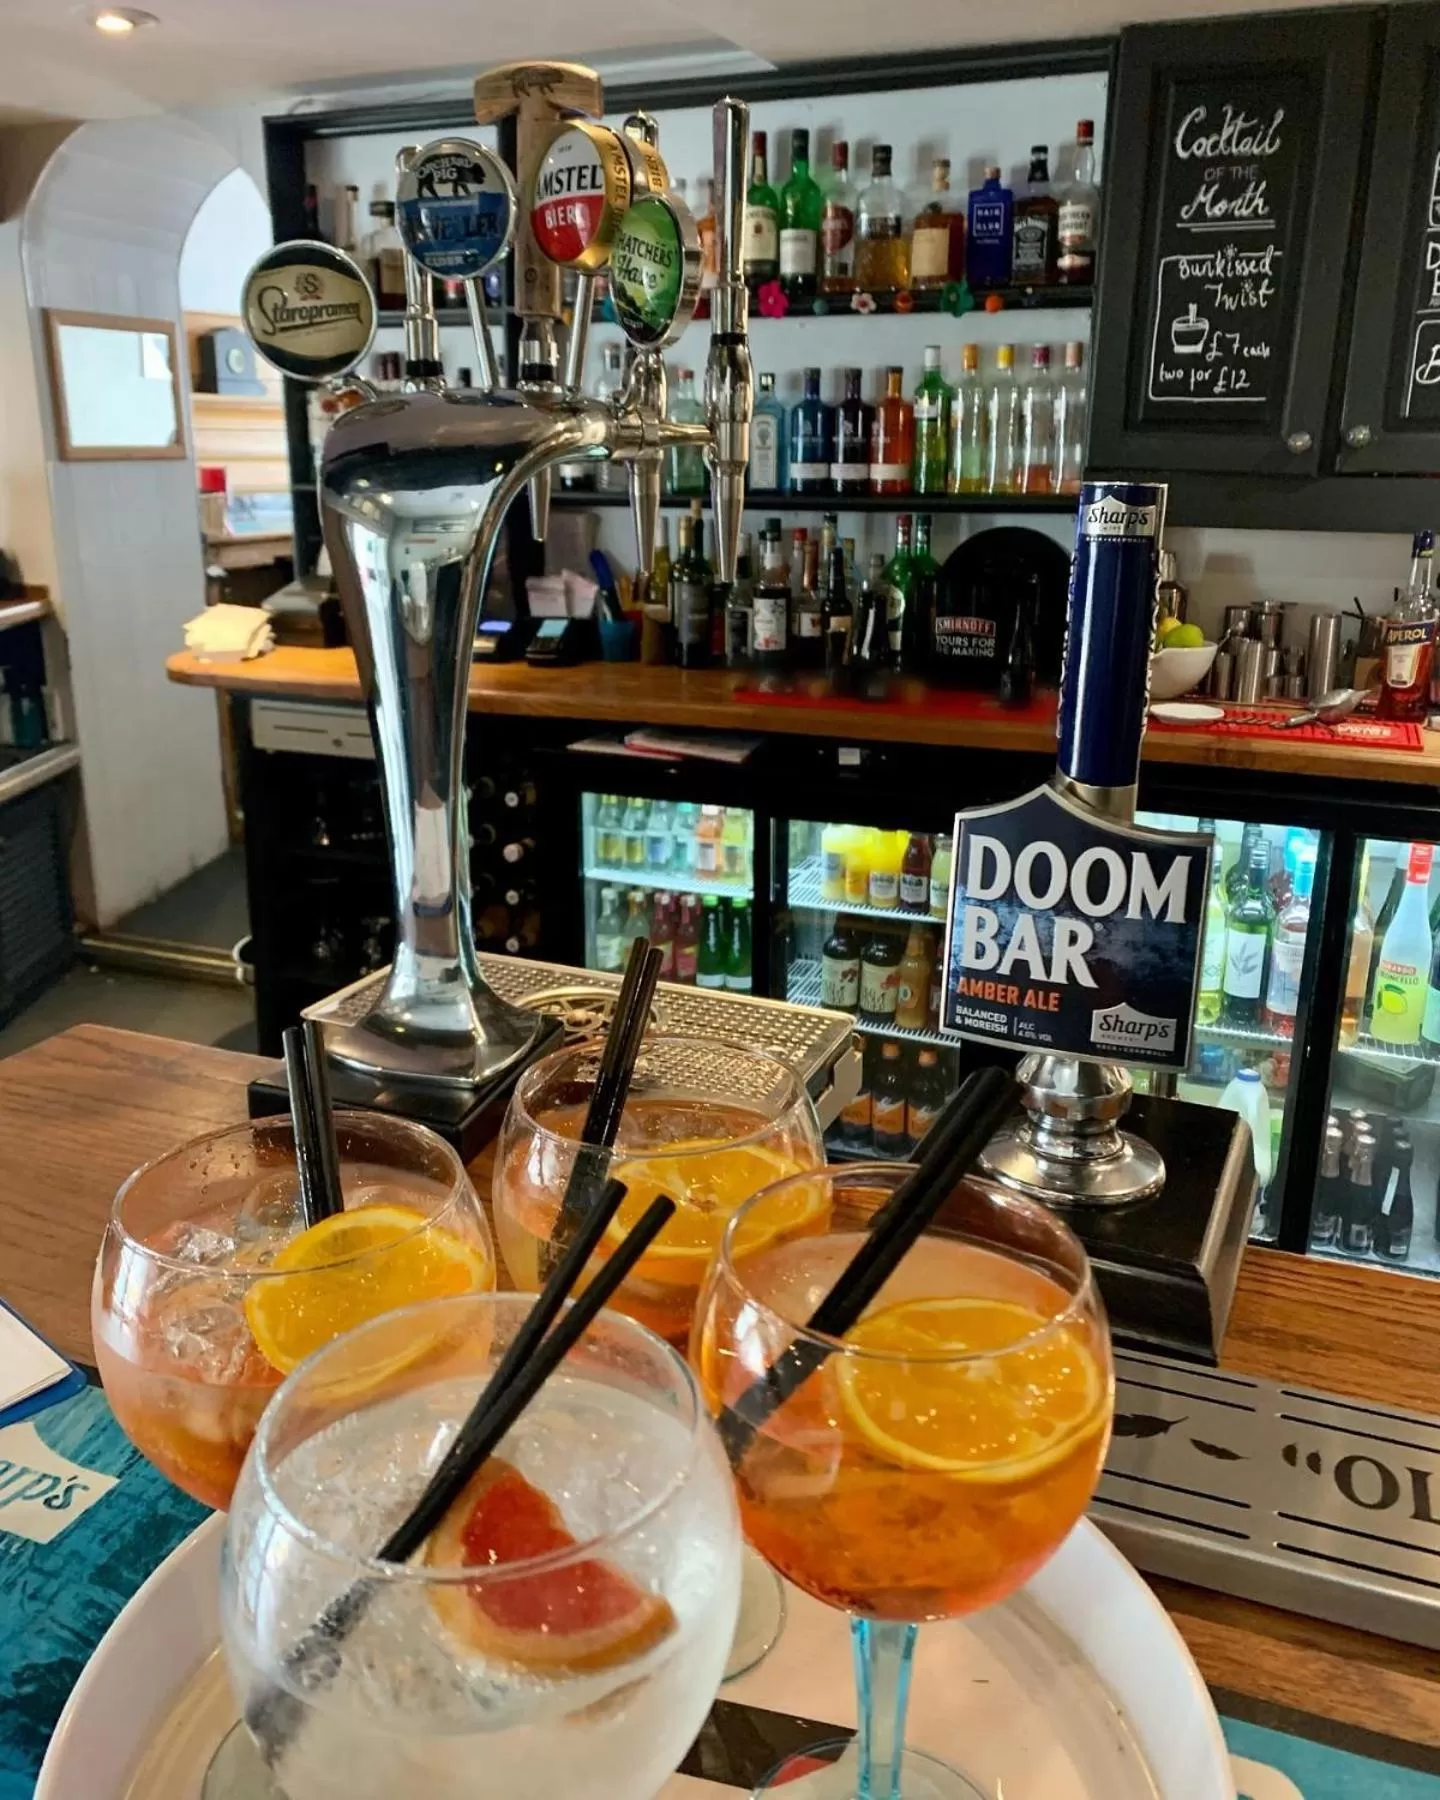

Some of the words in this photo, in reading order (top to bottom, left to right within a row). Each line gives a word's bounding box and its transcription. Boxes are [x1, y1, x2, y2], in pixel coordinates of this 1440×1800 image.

[1175, 104, 1284, 159] Cocktail
[431, 168, 458, 181] PIG
[1203, 167, 1225, 182] OF
[1230, 165, 1259, 181] THE
[1181, 180, 1269, 219] Month
[1178, 244, 1274, 279] Sunkissed
[1204, 278, 1275, 311] Twist
[257, 286, 363, 336] Staropramen
[1242, 342, 1270, 359] each
[1159, 363, 1184, 383] two
[1190, 368, 1212, 392] for
[1213, 366, 1250, 394] £12
[1088, 506, 1150, 528] Sharp's
[972, 638, 995, 648] FOR
[1388, 628, 1428, 643] APEROL
[952, 647, 994, 658] MAKING
[966, 834, 1192, 924] DOOM
[960, 905, 1099, 989] BAR
[956, 977, 1019, 1005] AMBER
[1023, 989, 1060, 1012] ALE
[956, 1005, 1008, 1023] BALANCED
[964, 1016, 1008, 1034] MOREISH
[1018, 1021, 1035, 1031] ALC
[1099, 1014, 1171, 1042] Sharp's
